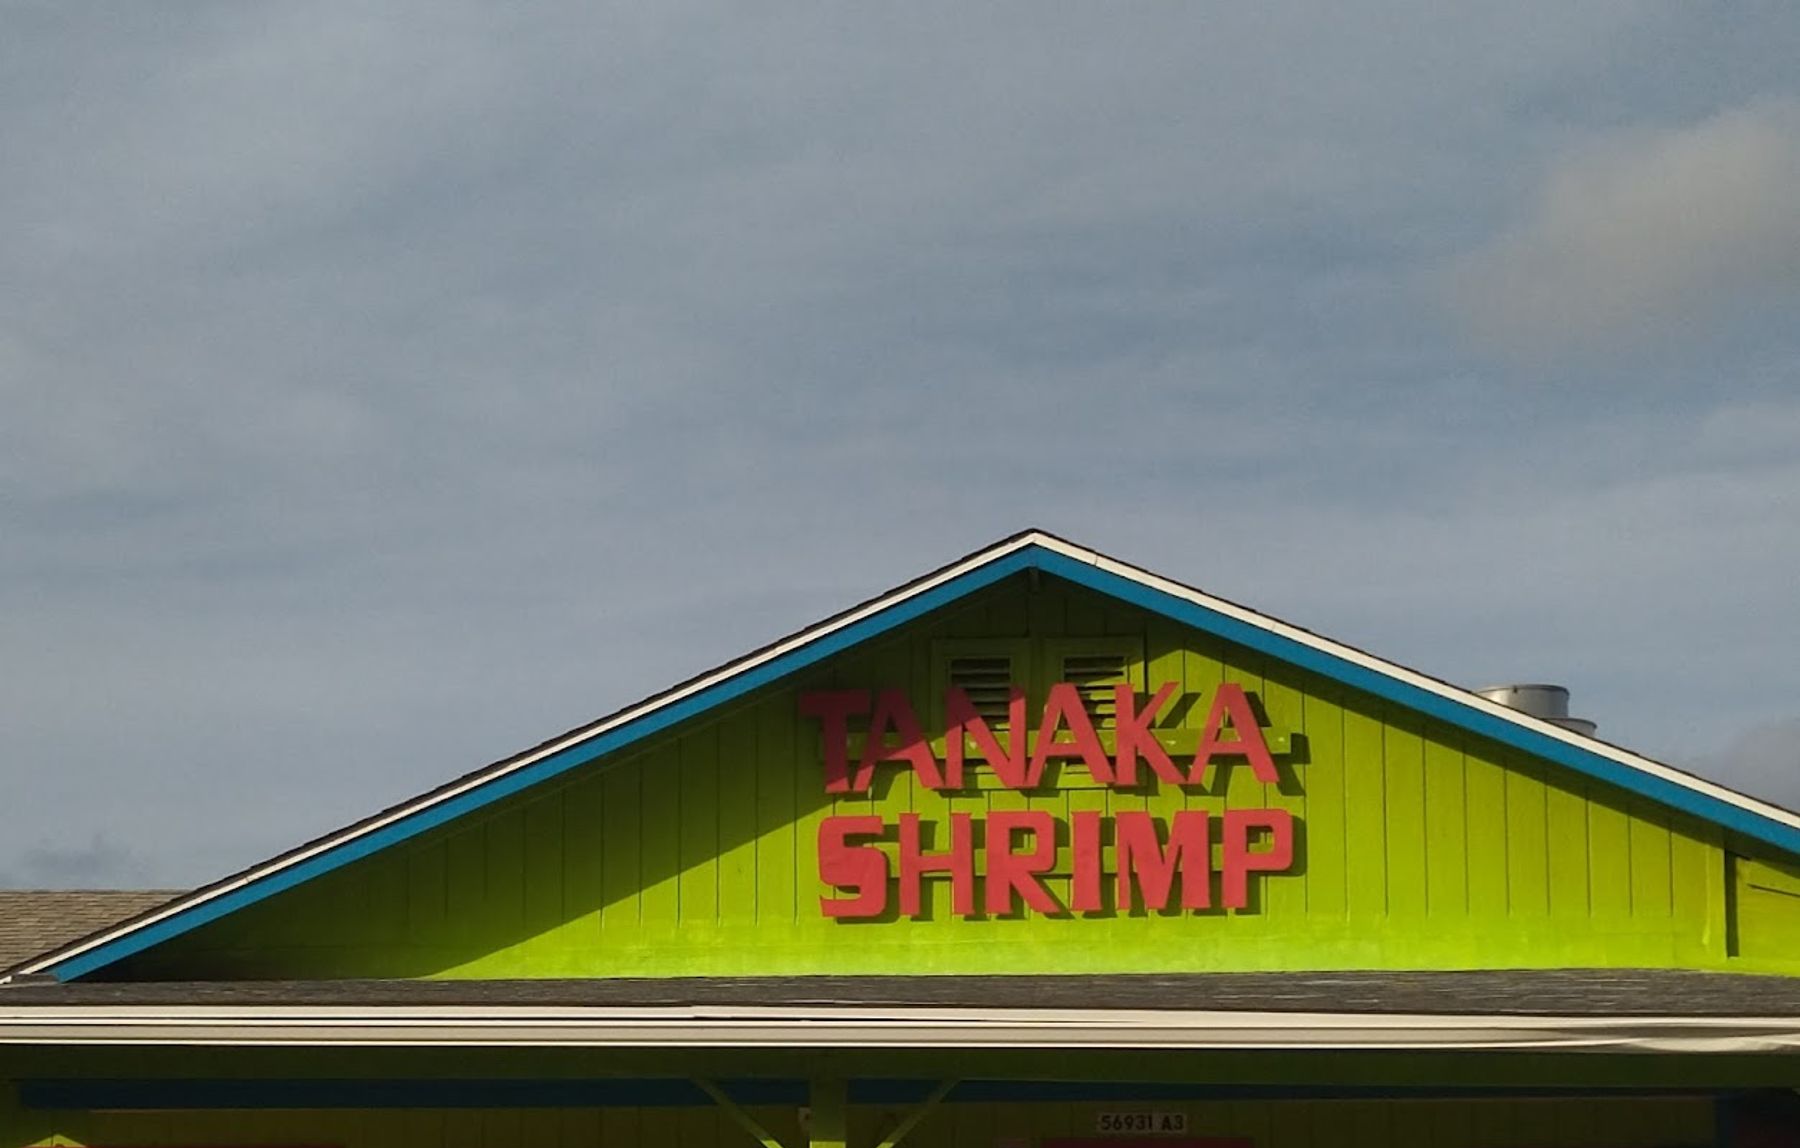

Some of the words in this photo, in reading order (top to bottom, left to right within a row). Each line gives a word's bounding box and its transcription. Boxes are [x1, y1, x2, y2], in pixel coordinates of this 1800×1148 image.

[801, 681, 1279, 794] TANAKA
[818, 809, 1294, 918] SHRIMP
[1101, 1114, 1153, 1131] 56931
[1161, 1114, 1184, 1131] A3
